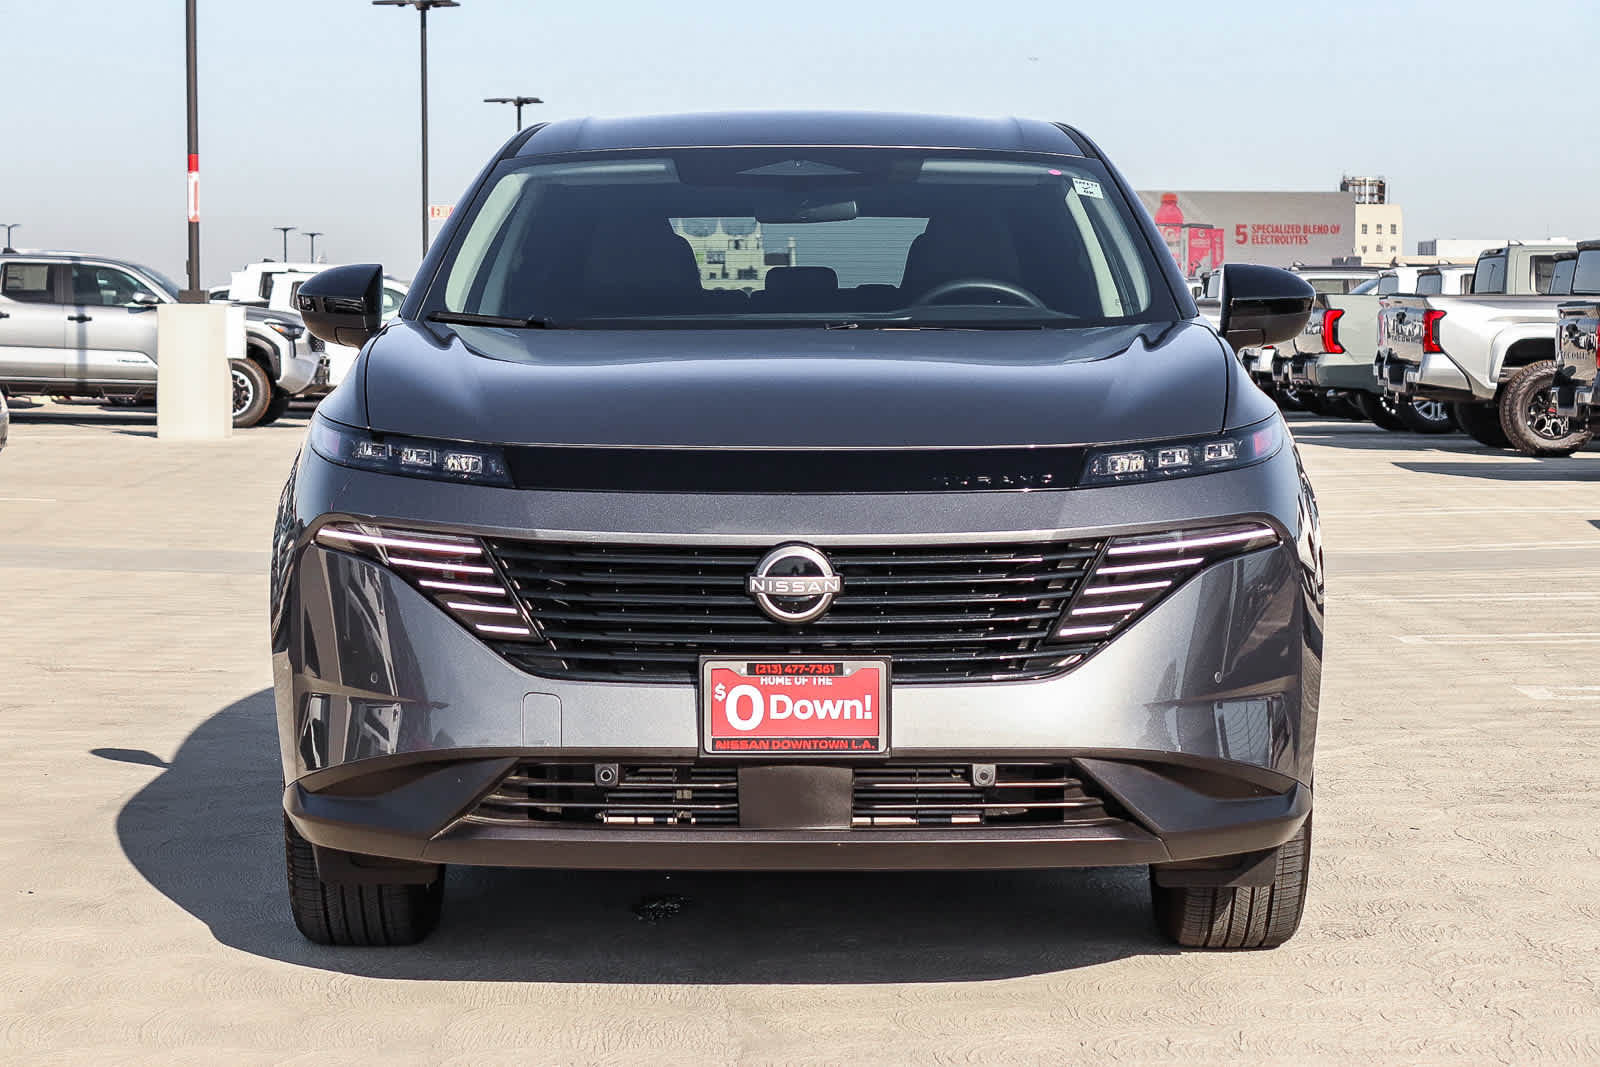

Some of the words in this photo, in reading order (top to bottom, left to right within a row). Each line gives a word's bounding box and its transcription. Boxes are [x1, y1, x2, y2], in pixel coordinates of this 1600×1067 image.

[1235, 224, 1248, 244] 5
[1251, 224, 1301, 234] SPECIALIZED
[1303, 224, 1329, 234] BLEND
[1330, 224, 1342, 234] OF
[1251, 235, 1309, 245] ELECTROLYTES
[750, 578, 840, 593] NISSAN
[755, 664, 782, 675] (213)
[784, 664, 836, 674] 477-7361
[760, 676, 792, 685] HOME
[794, 676, 808, 685] OF
[812, 676, 833, 685] THE
[769, 694, 873, 720] Down!
[715, 739, 769, 750] NISSAN
[771, 739, 848, 749] DOWNTOWN
[851, 739, 875, 749] L.A.
